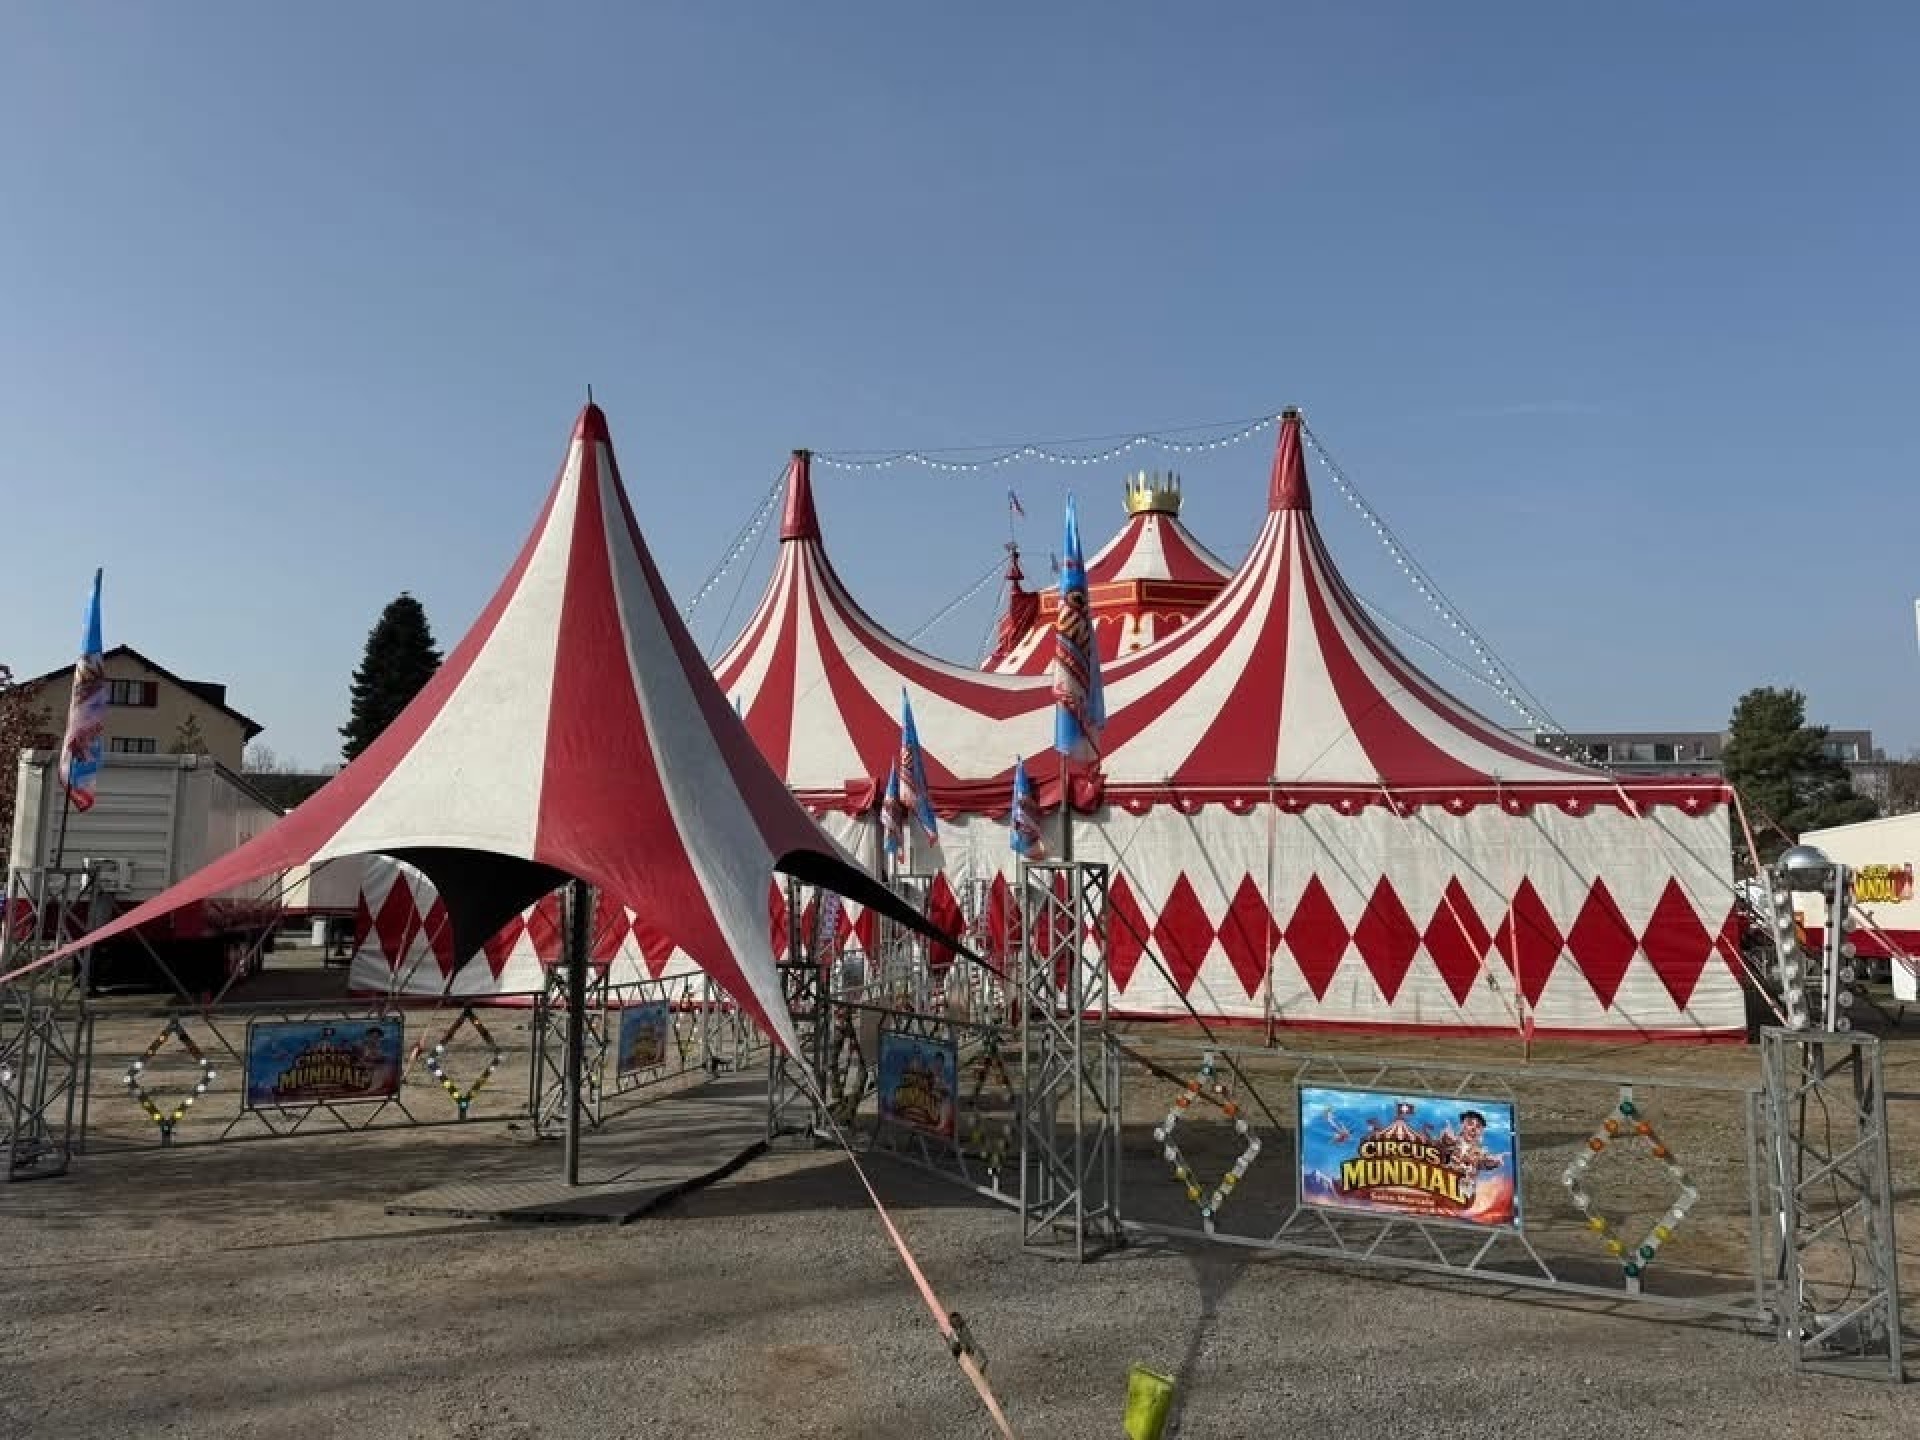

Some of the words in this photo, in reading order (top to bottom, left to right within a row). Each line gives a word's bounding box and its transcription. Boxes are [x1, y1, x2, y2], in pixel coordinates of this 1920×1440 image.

[279, 1065, 367, 1092] MUNDIAL
[1361, 1141, 1440, 1164] CIRCUS
[1343, 1159, 1467, 1203] MUNDIAL
